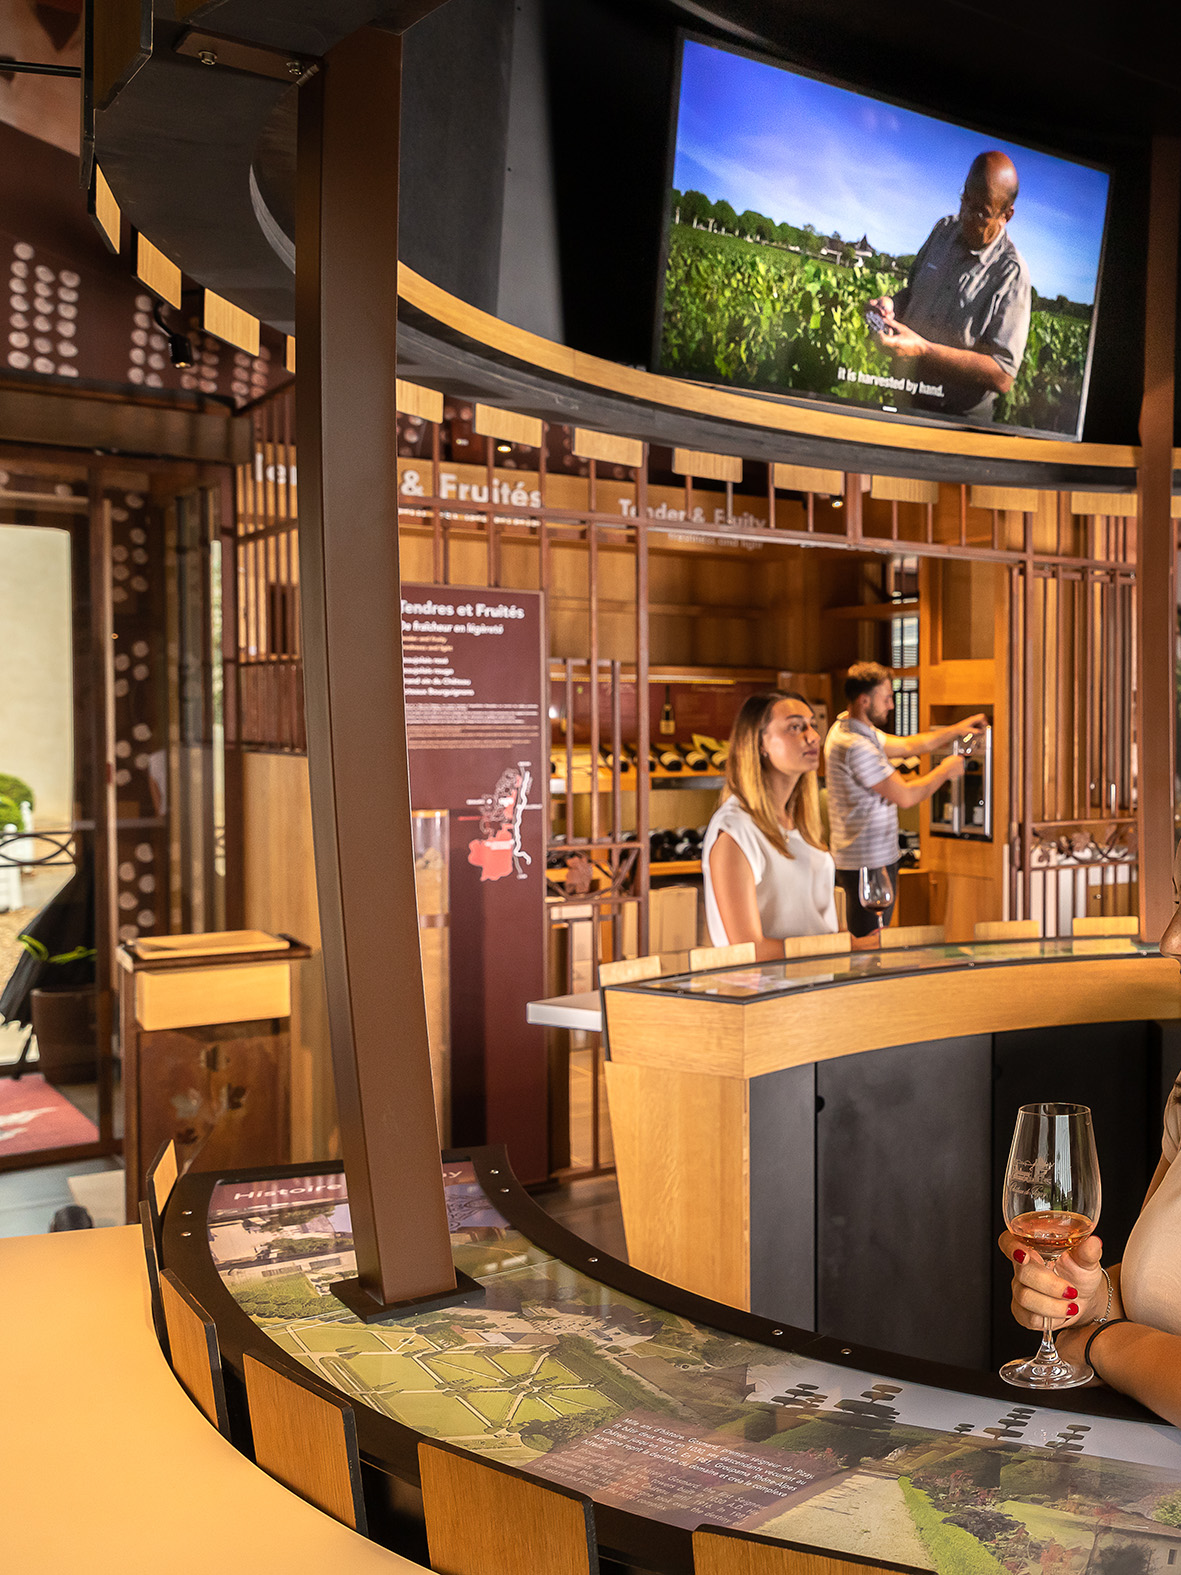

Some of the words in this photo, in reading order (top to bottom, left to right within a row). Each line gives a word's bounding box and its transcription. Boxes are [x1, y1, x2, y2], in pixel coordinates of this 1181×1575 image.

[858, 370, 905, 391] harvested
[906, 378, 918, 396] by
[919, 381, 945, 398] hand.
[401, 470, 424, 497] &
[439, 473, 541, 508] Fruités
[456, 604, 474, 617] et
[475, 603, 525, 619] Fruités
[234, 1183, 342, 1200] Histoire
[591, 1434, 623, 1446] Auvergne
[649, 1452, 678, 1463] destinée
[688, 1464, 719, 1475] domaine
[727, 1476, 744, 1484] créa
[752, 1484, 787, 1496] complexe
[602, 1428, 629, 1439] Château
[714, 1462, 750, 1476] Groupama
[656, 1436, 674, 1445] tours
[719, 1456, 762, 1471] descendants
[719, 1448, 749, 1458] premier
[750, 1457, 781, 1467] seigneur
